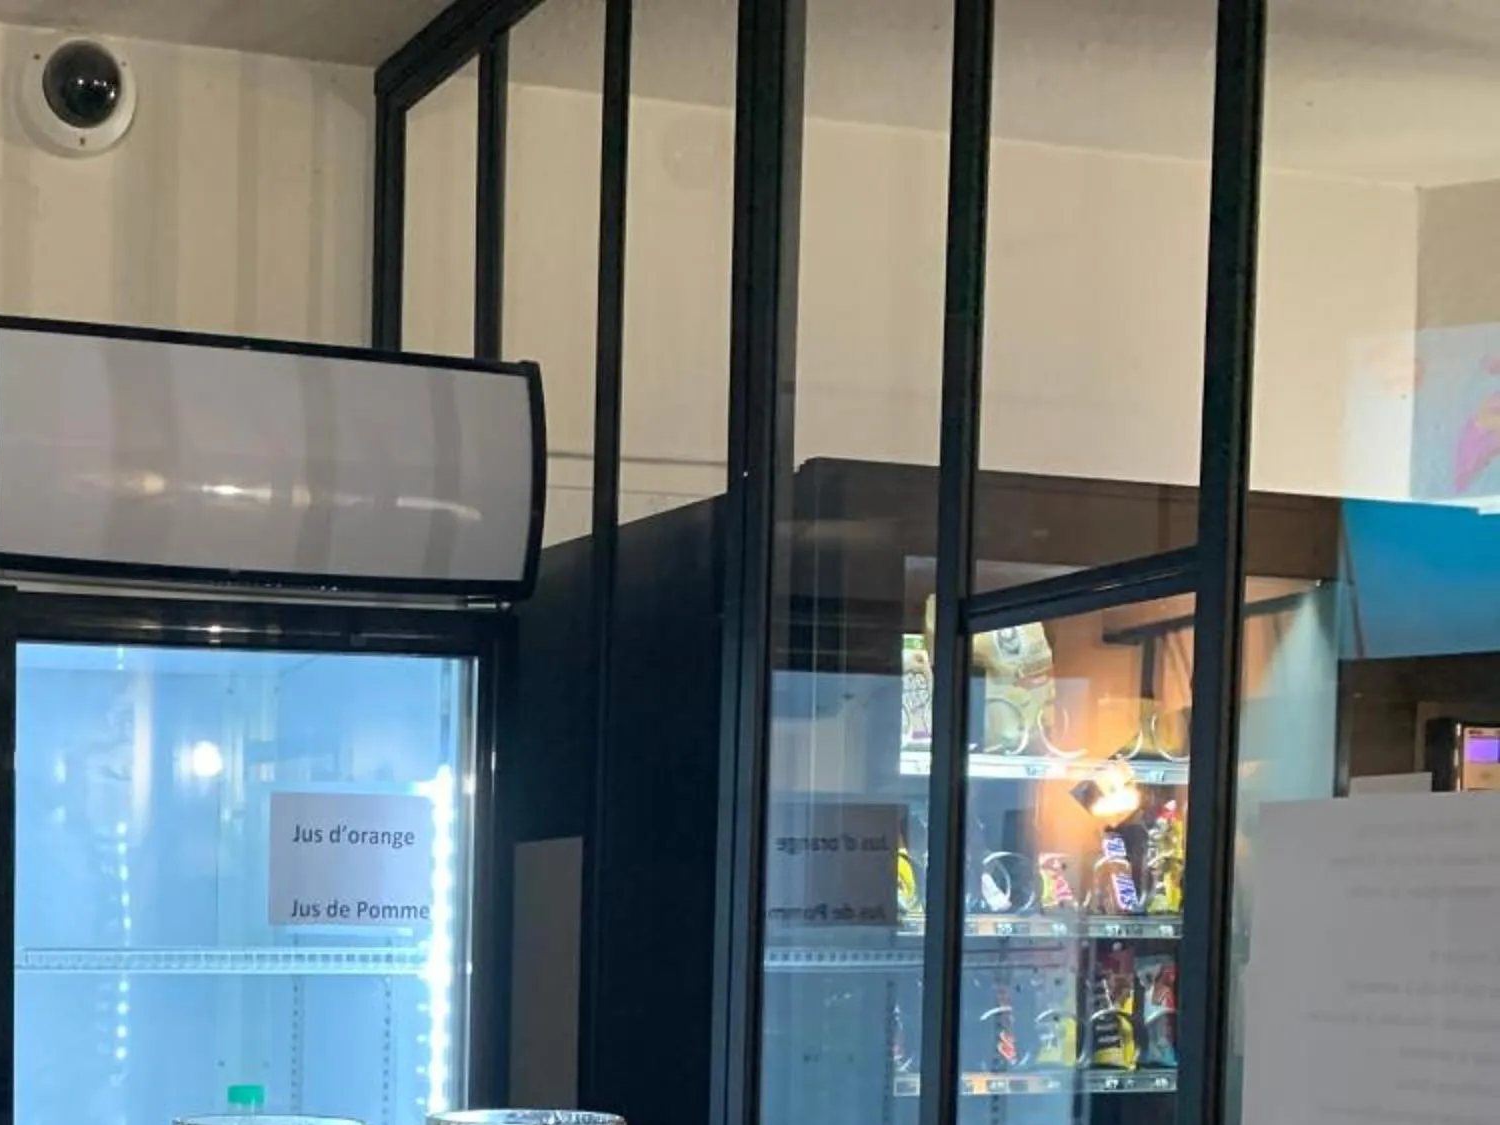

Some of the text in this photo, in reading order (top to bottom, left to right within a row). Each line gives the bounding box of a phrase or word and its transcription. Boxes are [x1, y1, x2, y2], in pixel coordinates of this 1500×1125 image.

[292, 825, 415, 848] Jus d'orange
[291, 900, 430, 919] Jus de Pomme
